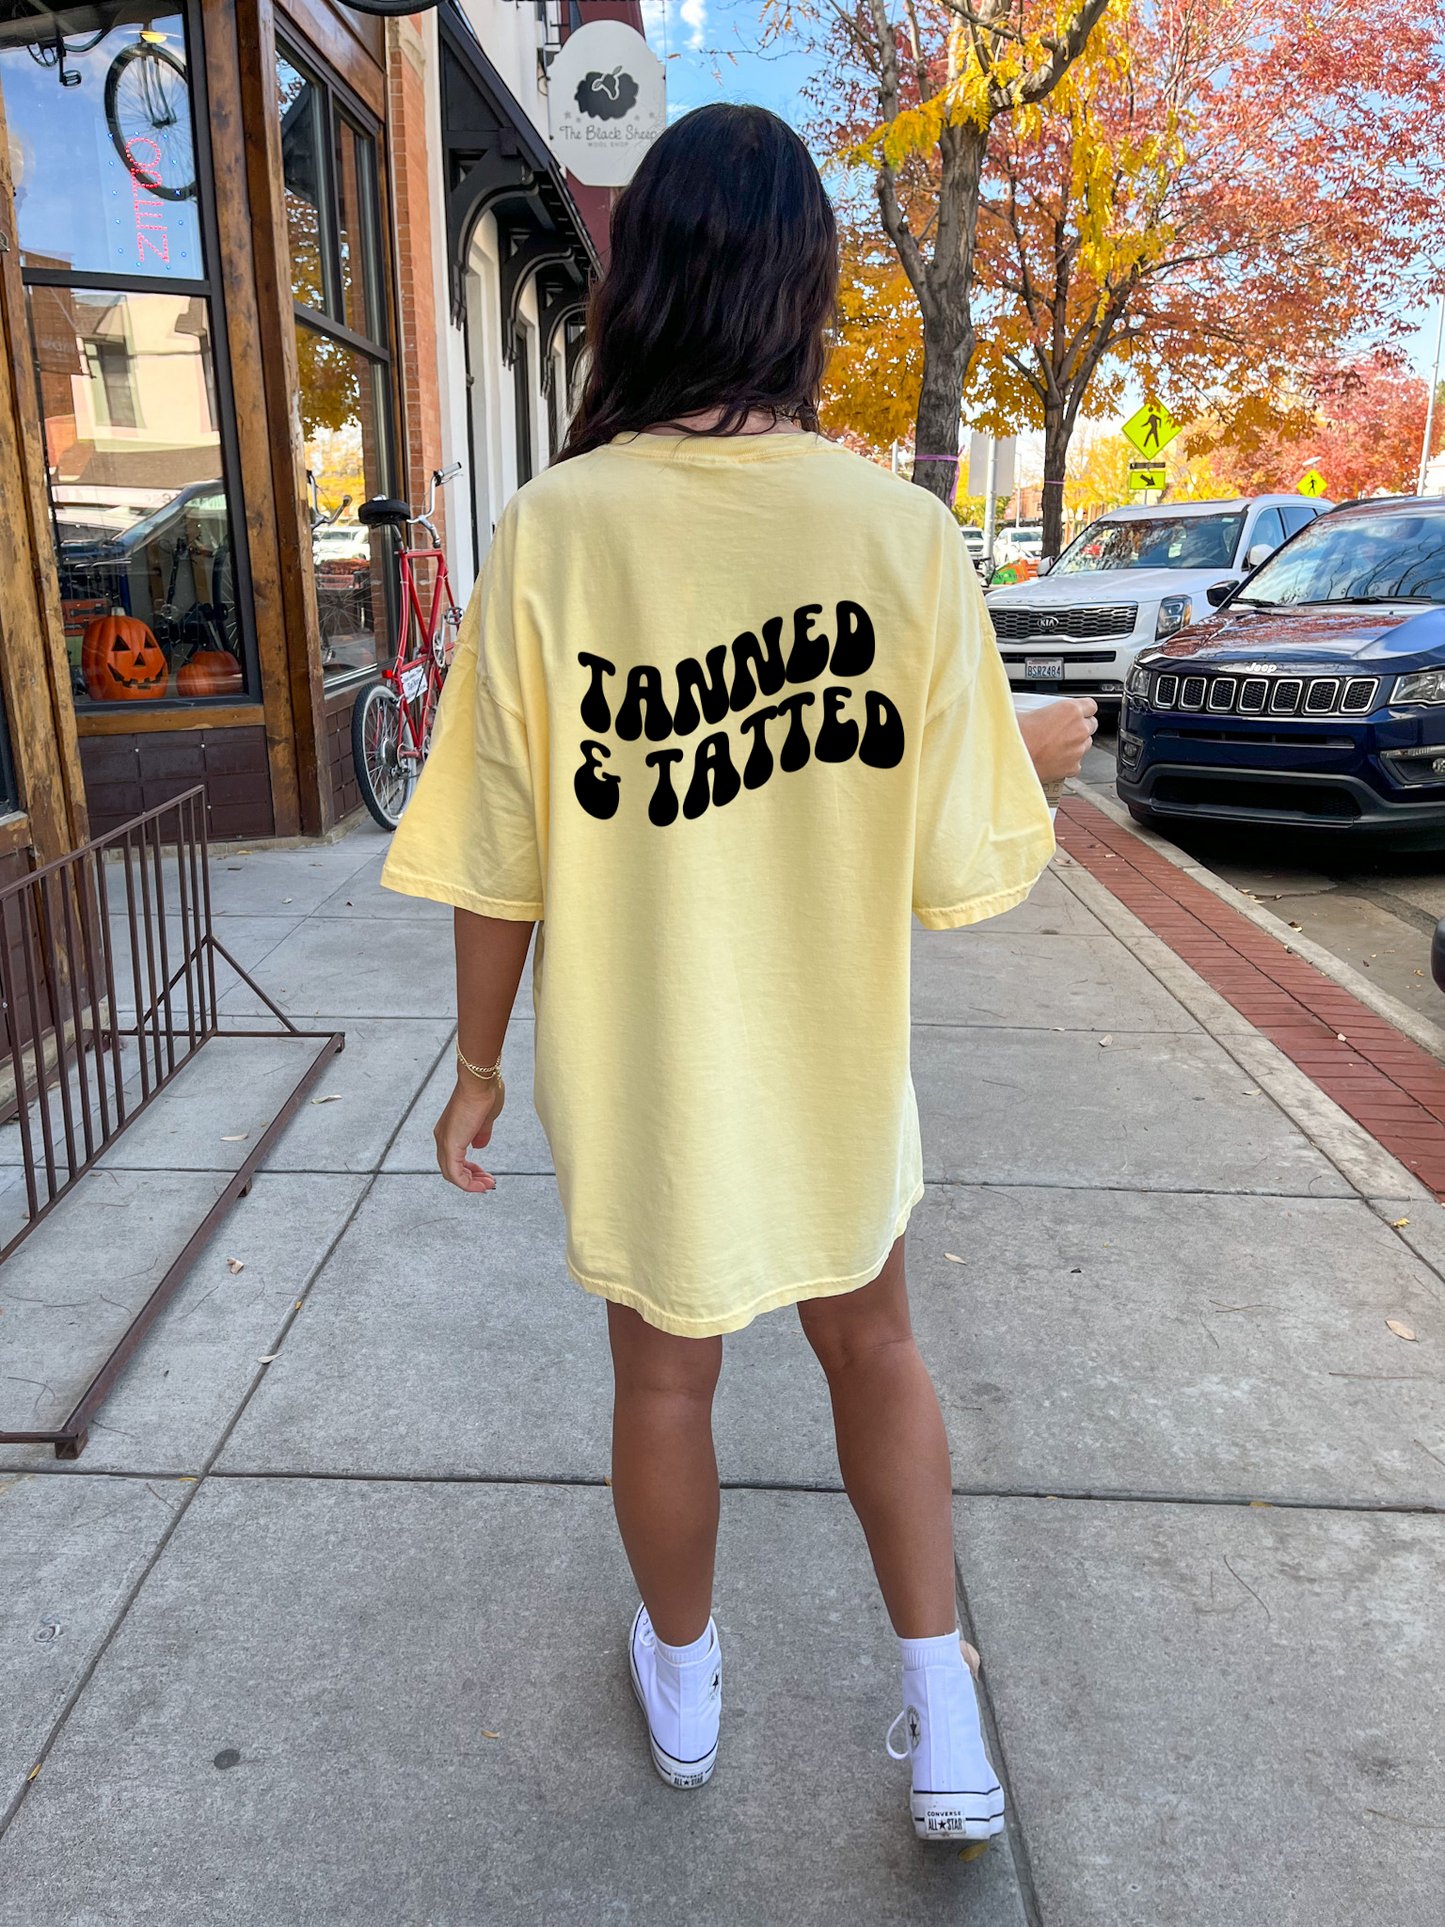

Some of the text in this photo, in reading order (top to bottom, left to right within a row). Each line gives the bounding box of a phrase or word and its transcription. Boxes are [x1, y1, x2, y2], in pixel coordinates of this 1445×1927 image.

[559, 126, 582, 140] The
[586, 124, 621, 140] Black
[125, 138, 169, 263] OPEN
[578, 600, 875, 742] TANNED
[1245, 662, 1277, 674] Jeep
[574, 686, 905, 827] & TATTED
[928, 1817, 963, 1831] ALL STAR
